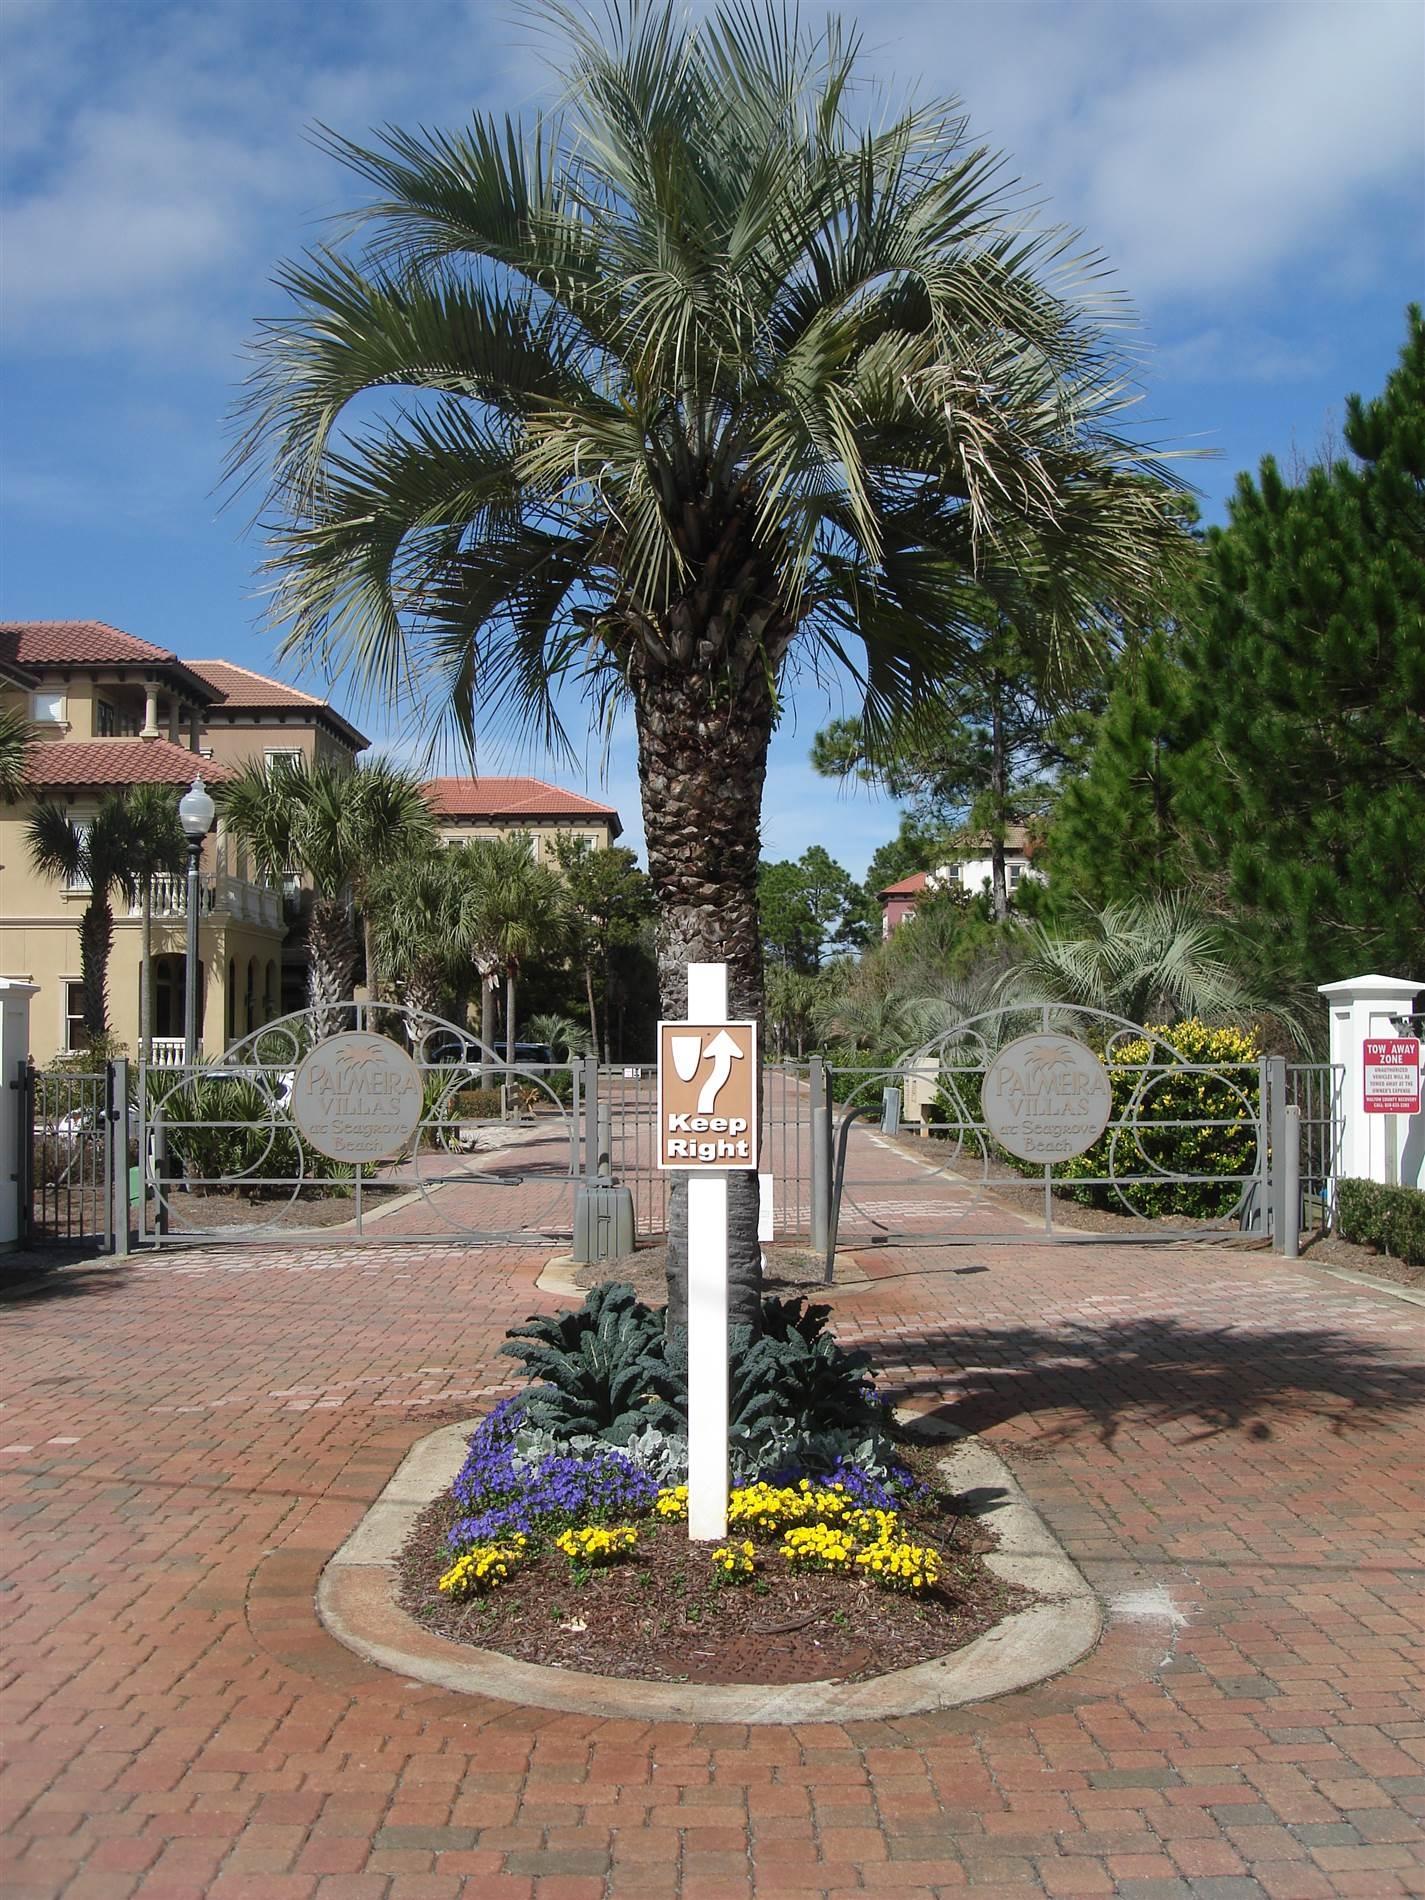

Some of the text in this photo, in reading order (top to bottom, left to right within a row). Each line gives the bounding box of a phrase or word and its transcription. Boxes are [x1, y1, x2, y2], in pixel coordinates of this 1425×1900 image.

[1367, 1044, 1415, 1054] TOW AWAY
[1380, 1054, 1403, 1064] ZONE
[319, 1098, 401, 1116] VILLAS
[1008, 1098, 1090, 1117] VILLAS
[331, 1120, 409, 1138] Seagrove
[669, 1114, 748, 1136] Keep
[1022, 1120, 1098, 1138] Seagrove
[334, 1137, 384, 1152] Beach
[667, 1139, 750, 1162] Right
[1024, 1137, 1073, 1152] Beach
